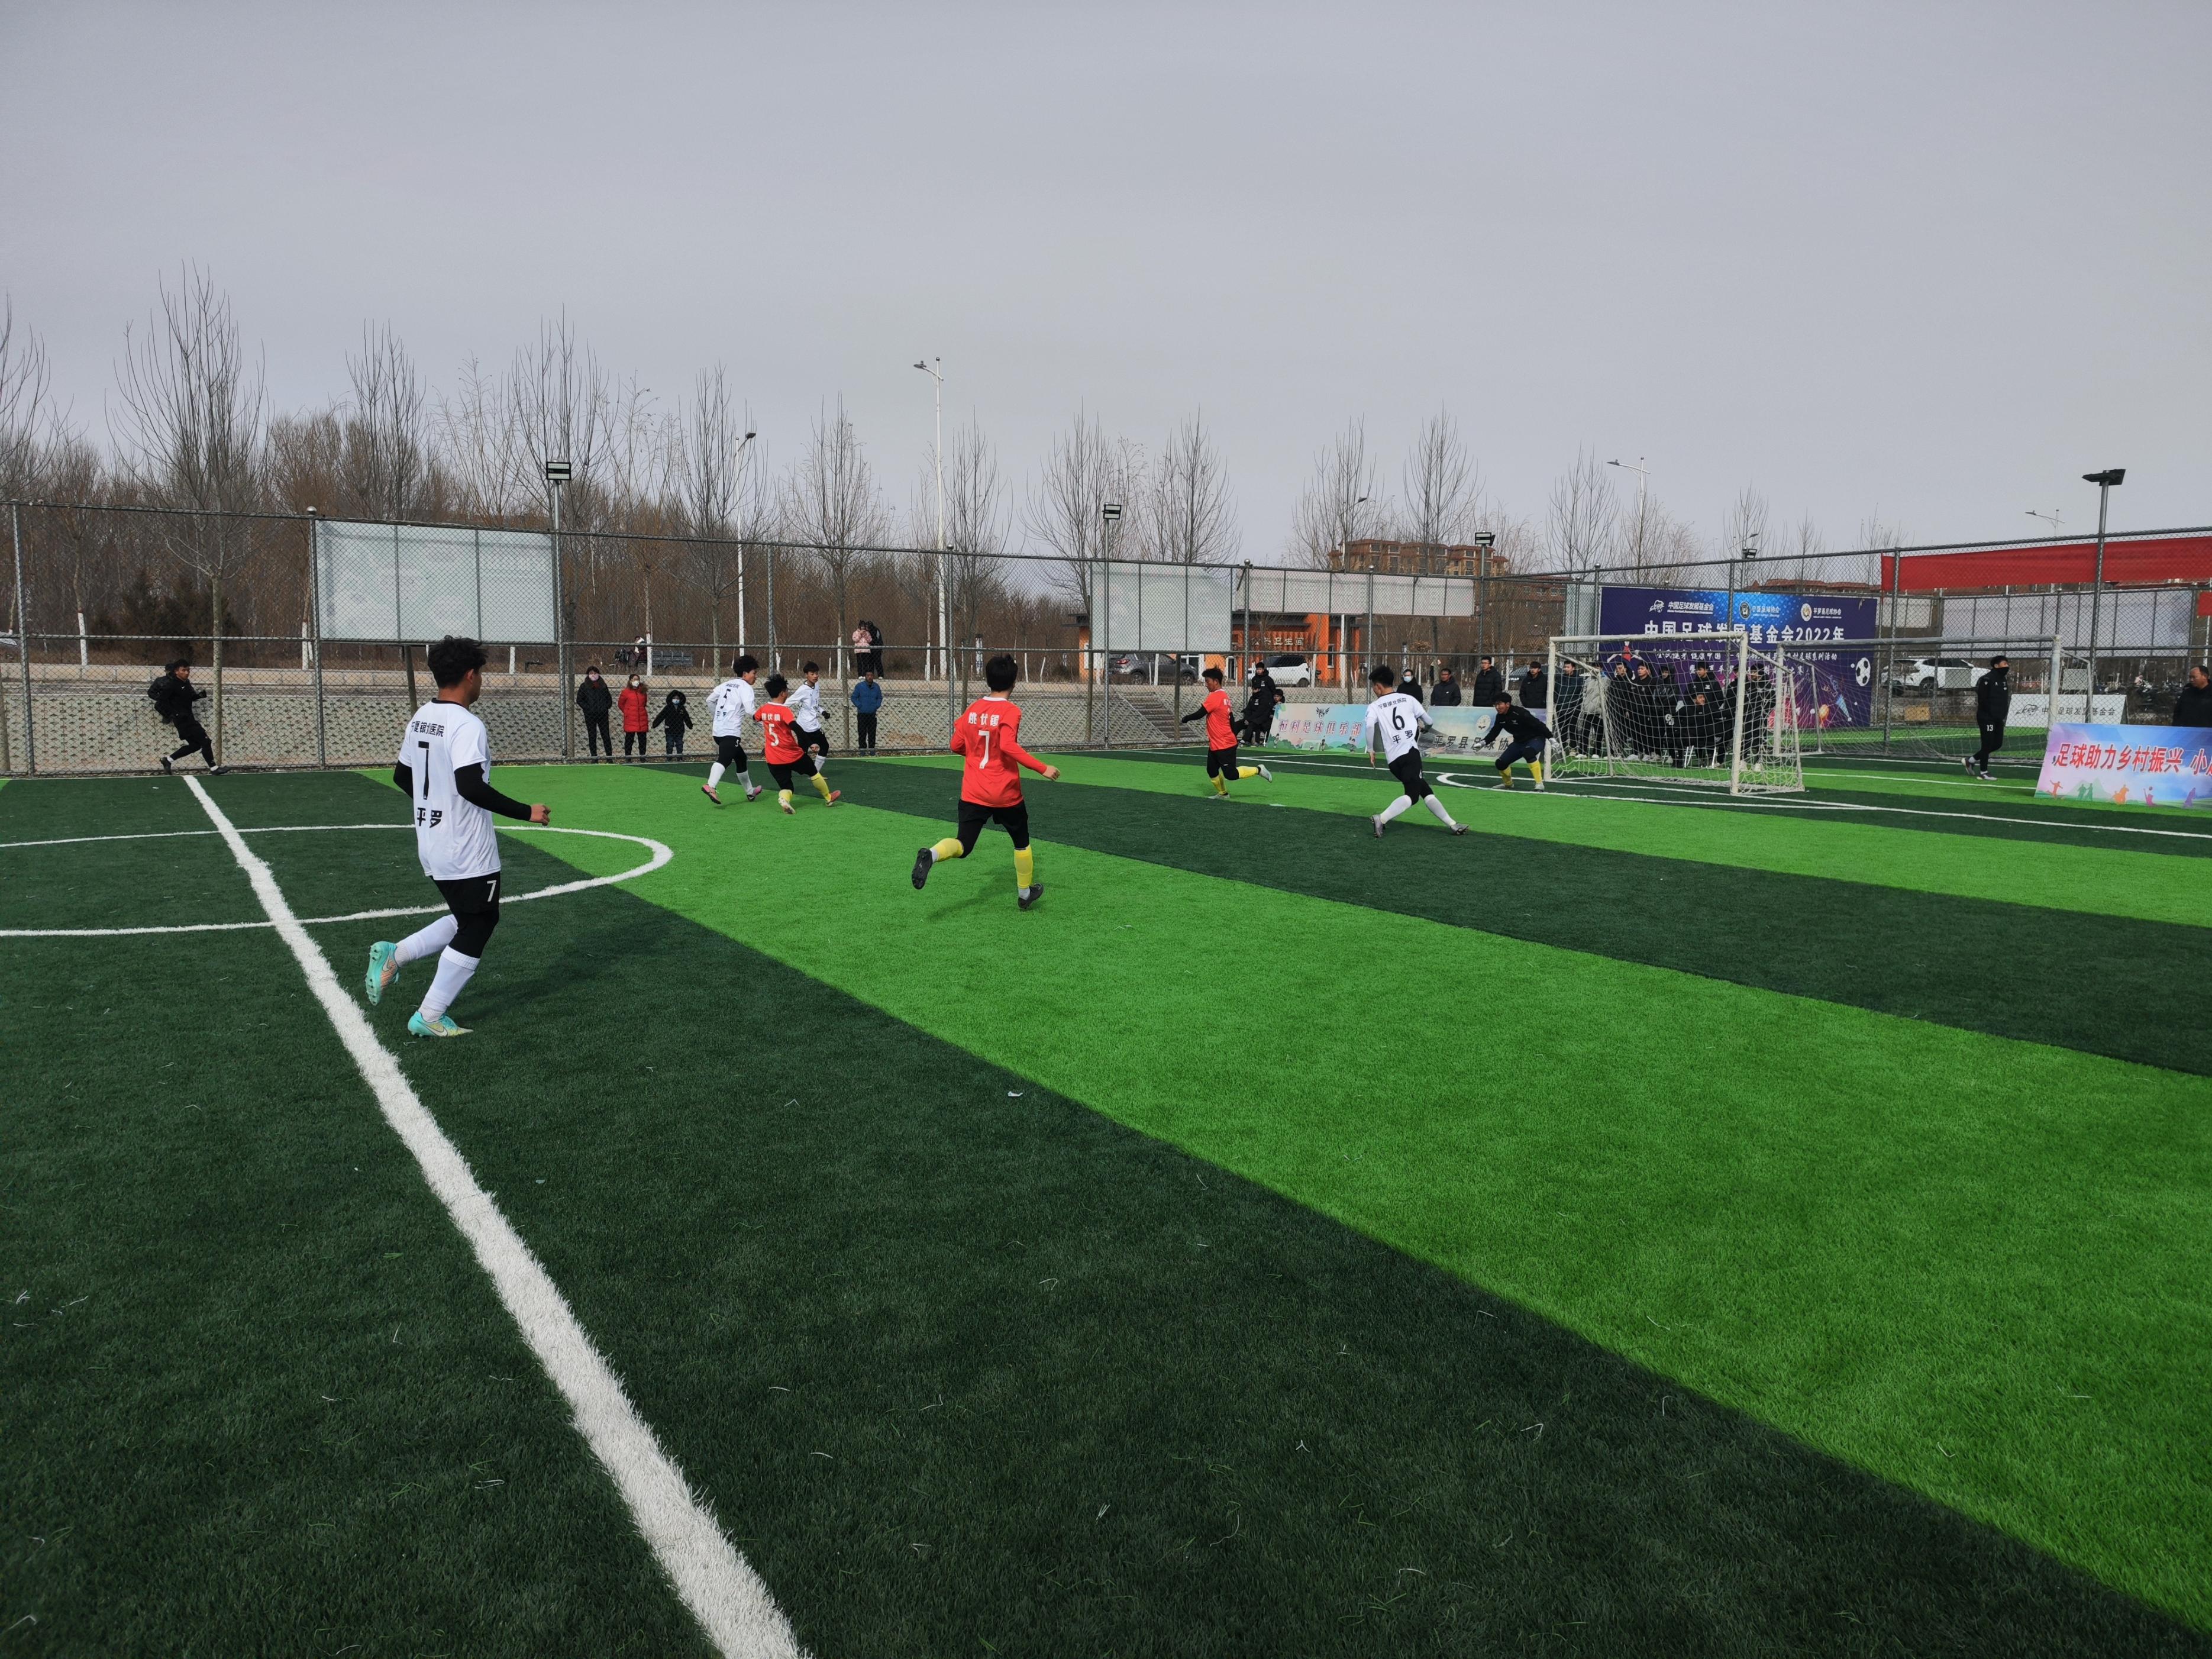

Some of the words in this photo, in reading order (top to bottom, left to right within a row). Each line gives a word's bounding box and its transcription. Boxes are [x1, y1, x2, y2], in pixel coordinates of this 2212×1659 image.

[720, 688, 731, 709] 5
[1392, 706, 1405, 731] 6
[2042, 706, 2116, 716] 中足球发基金会
[768, 723, 779, 747] 5
[1392, 730, 1413, 744] 平罗
[978, 730, 990, 769] 7
[2053, 743, 2184, 773] 足球助力乡村振兴
[2190, 749, 2212, 777] 小
[418, 741, 430, 800] 7
[416, 807, 443, 828] 平罗
[487, 880, 497, 902] 7
